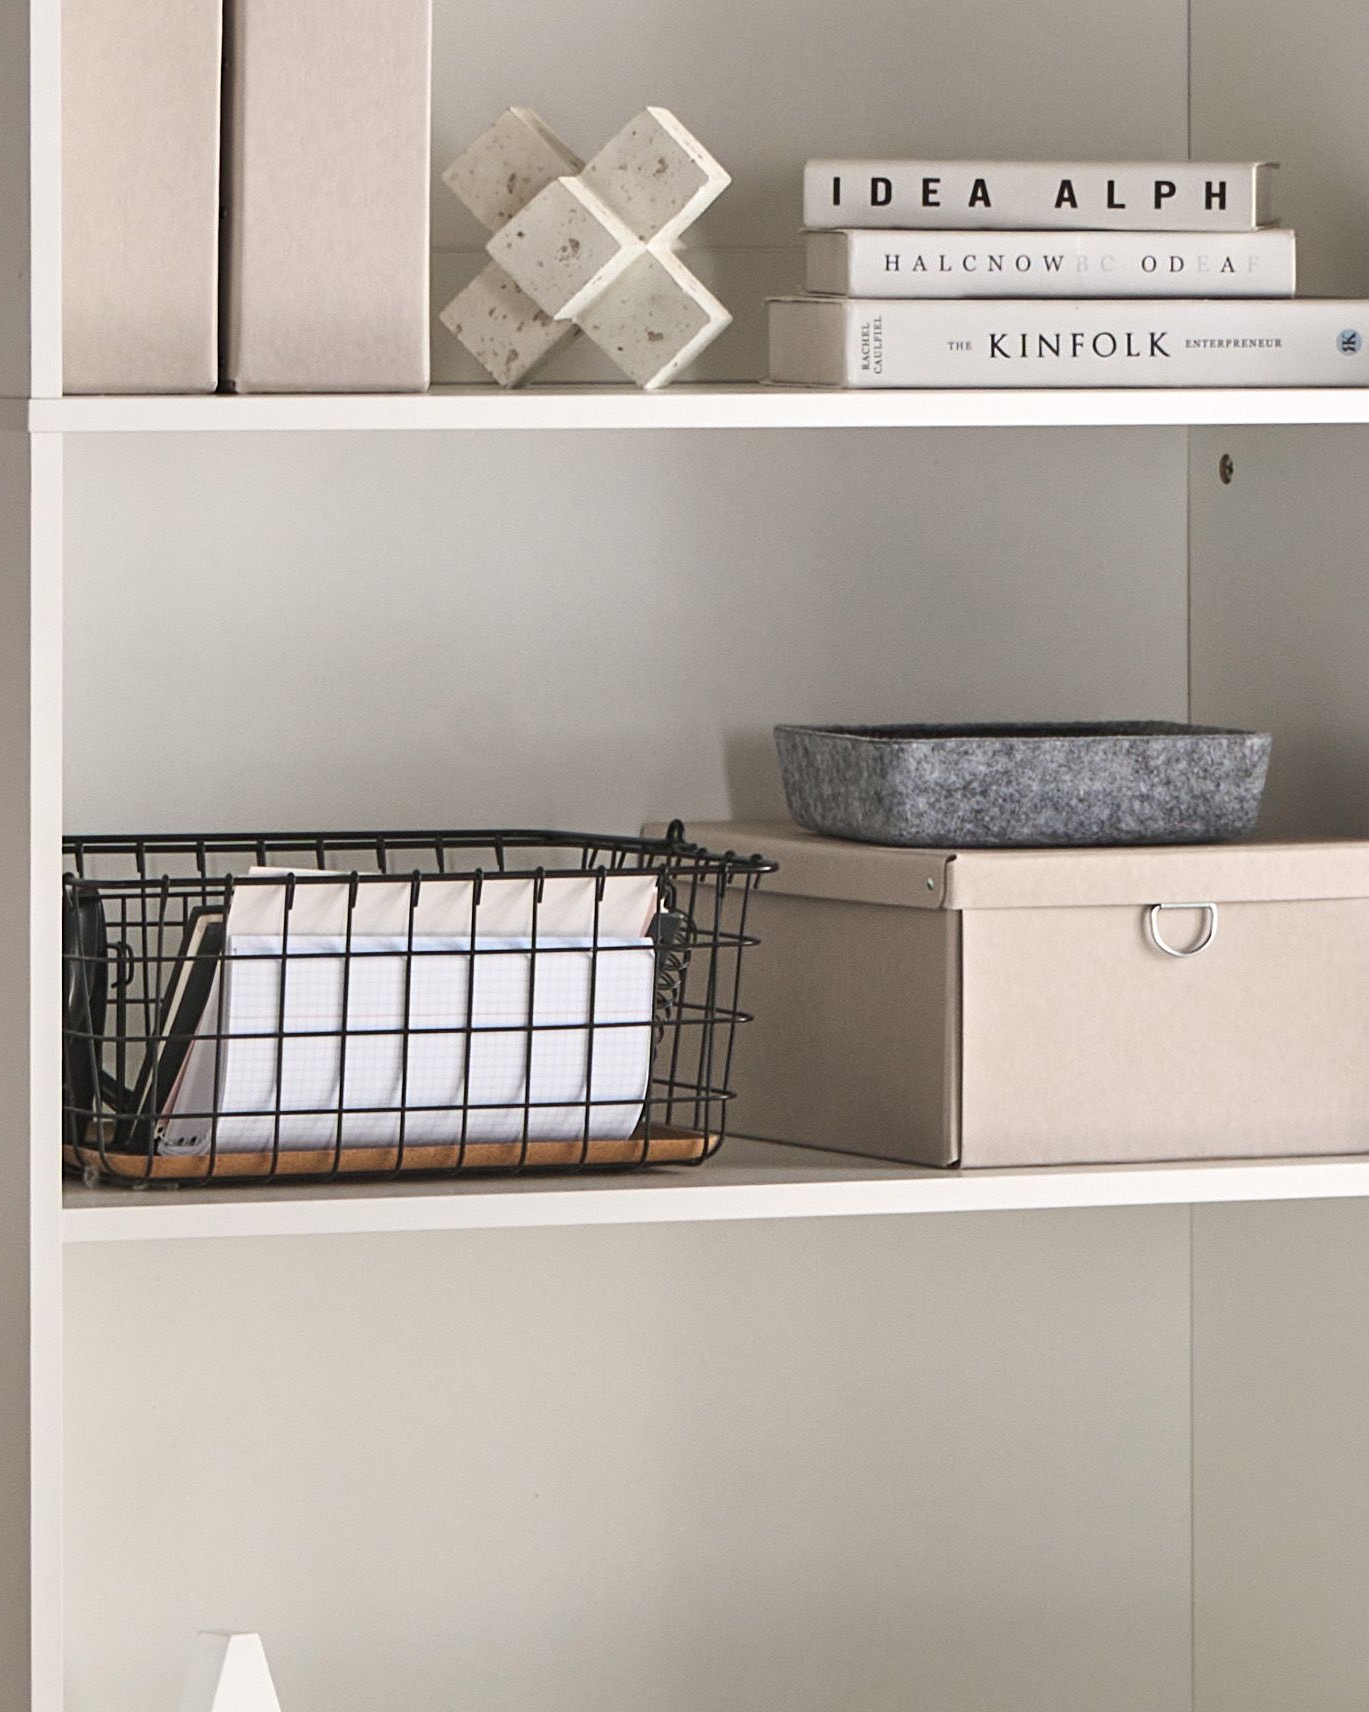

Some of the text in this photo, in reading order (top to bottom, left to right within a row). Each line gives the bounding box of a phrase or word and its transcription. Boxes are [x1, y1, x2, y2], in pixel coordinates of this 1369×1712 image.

[832, 176, 1228, 211] IDEA ALPH
[861, 322, 870, 370] RACHEL
[948, 332, 1282, 358] THE KINFOLK ENTERPRENEUR
